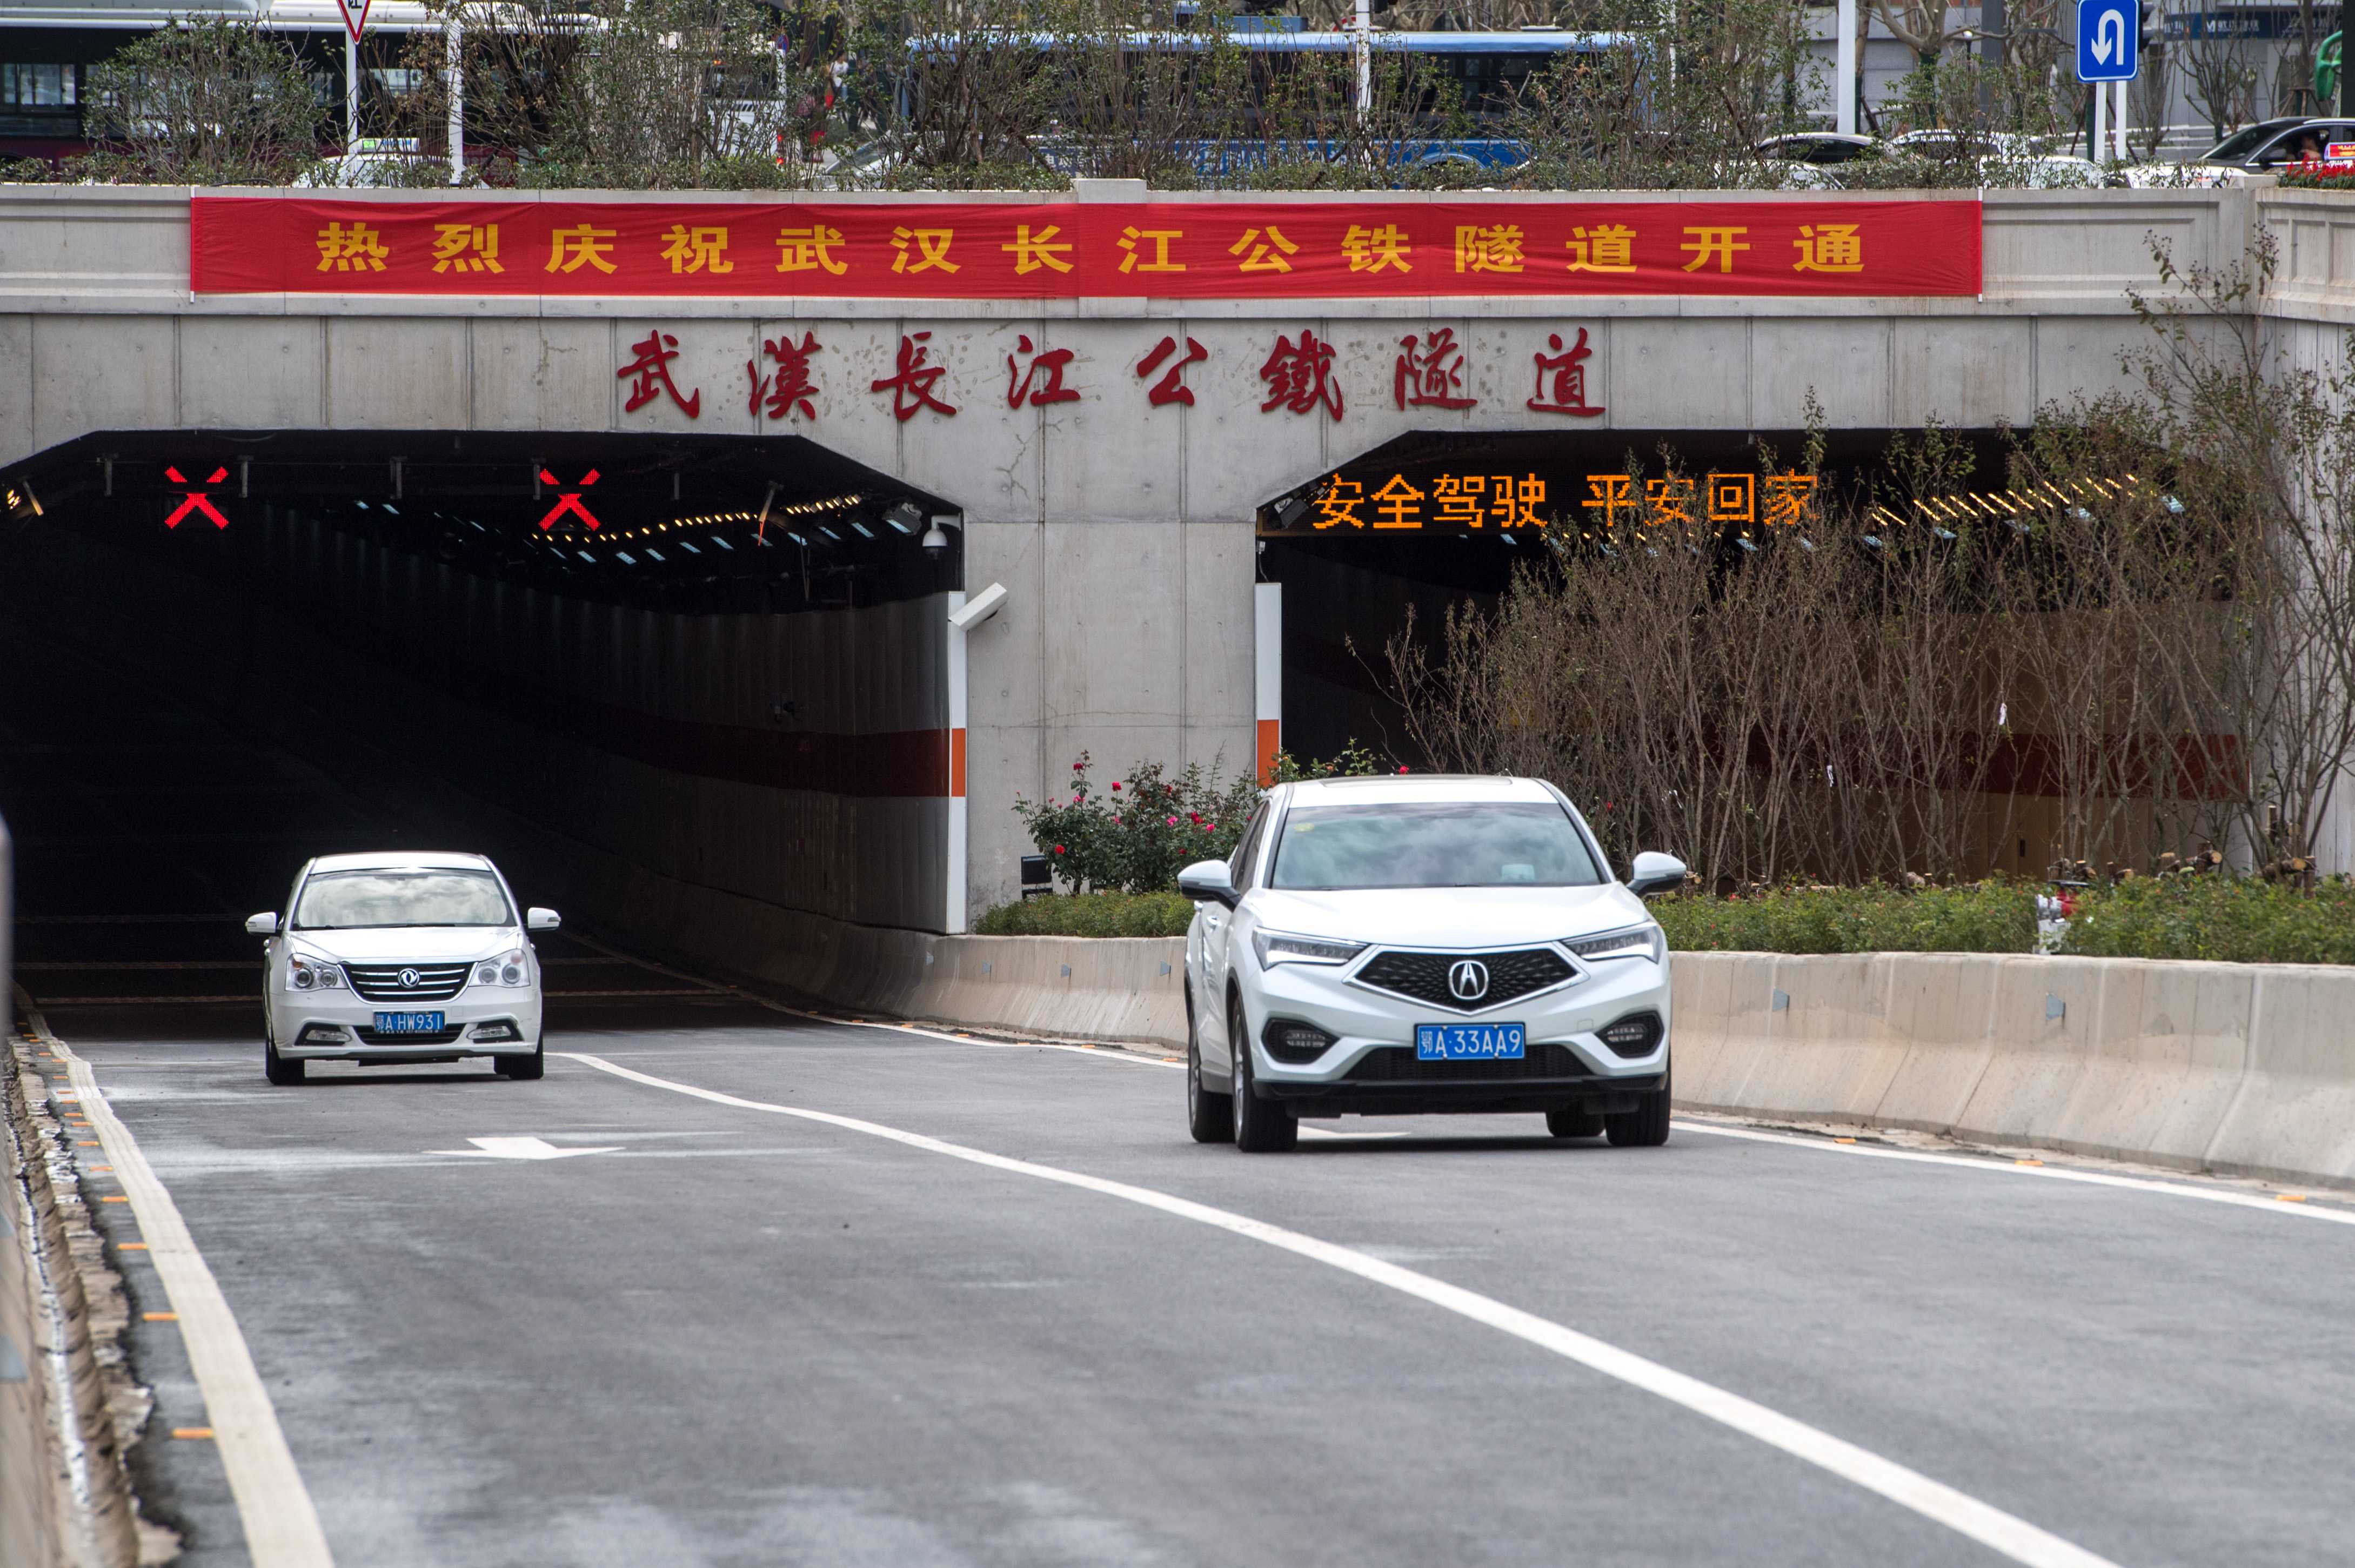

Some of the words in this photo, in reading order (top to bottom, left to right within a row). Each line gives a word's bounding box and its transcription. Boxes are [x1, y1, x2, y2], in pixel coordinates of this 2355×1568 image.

[316, 223, 1864, 275] 热烈庆祝武汉长江公铁隧道开通
[618, 327, 1605, 421] 武漢長江公鐵隧道
[1313, 473, 1548, 529] 安全驾驶
[1582, 468, 1818, 526] 平安回家
